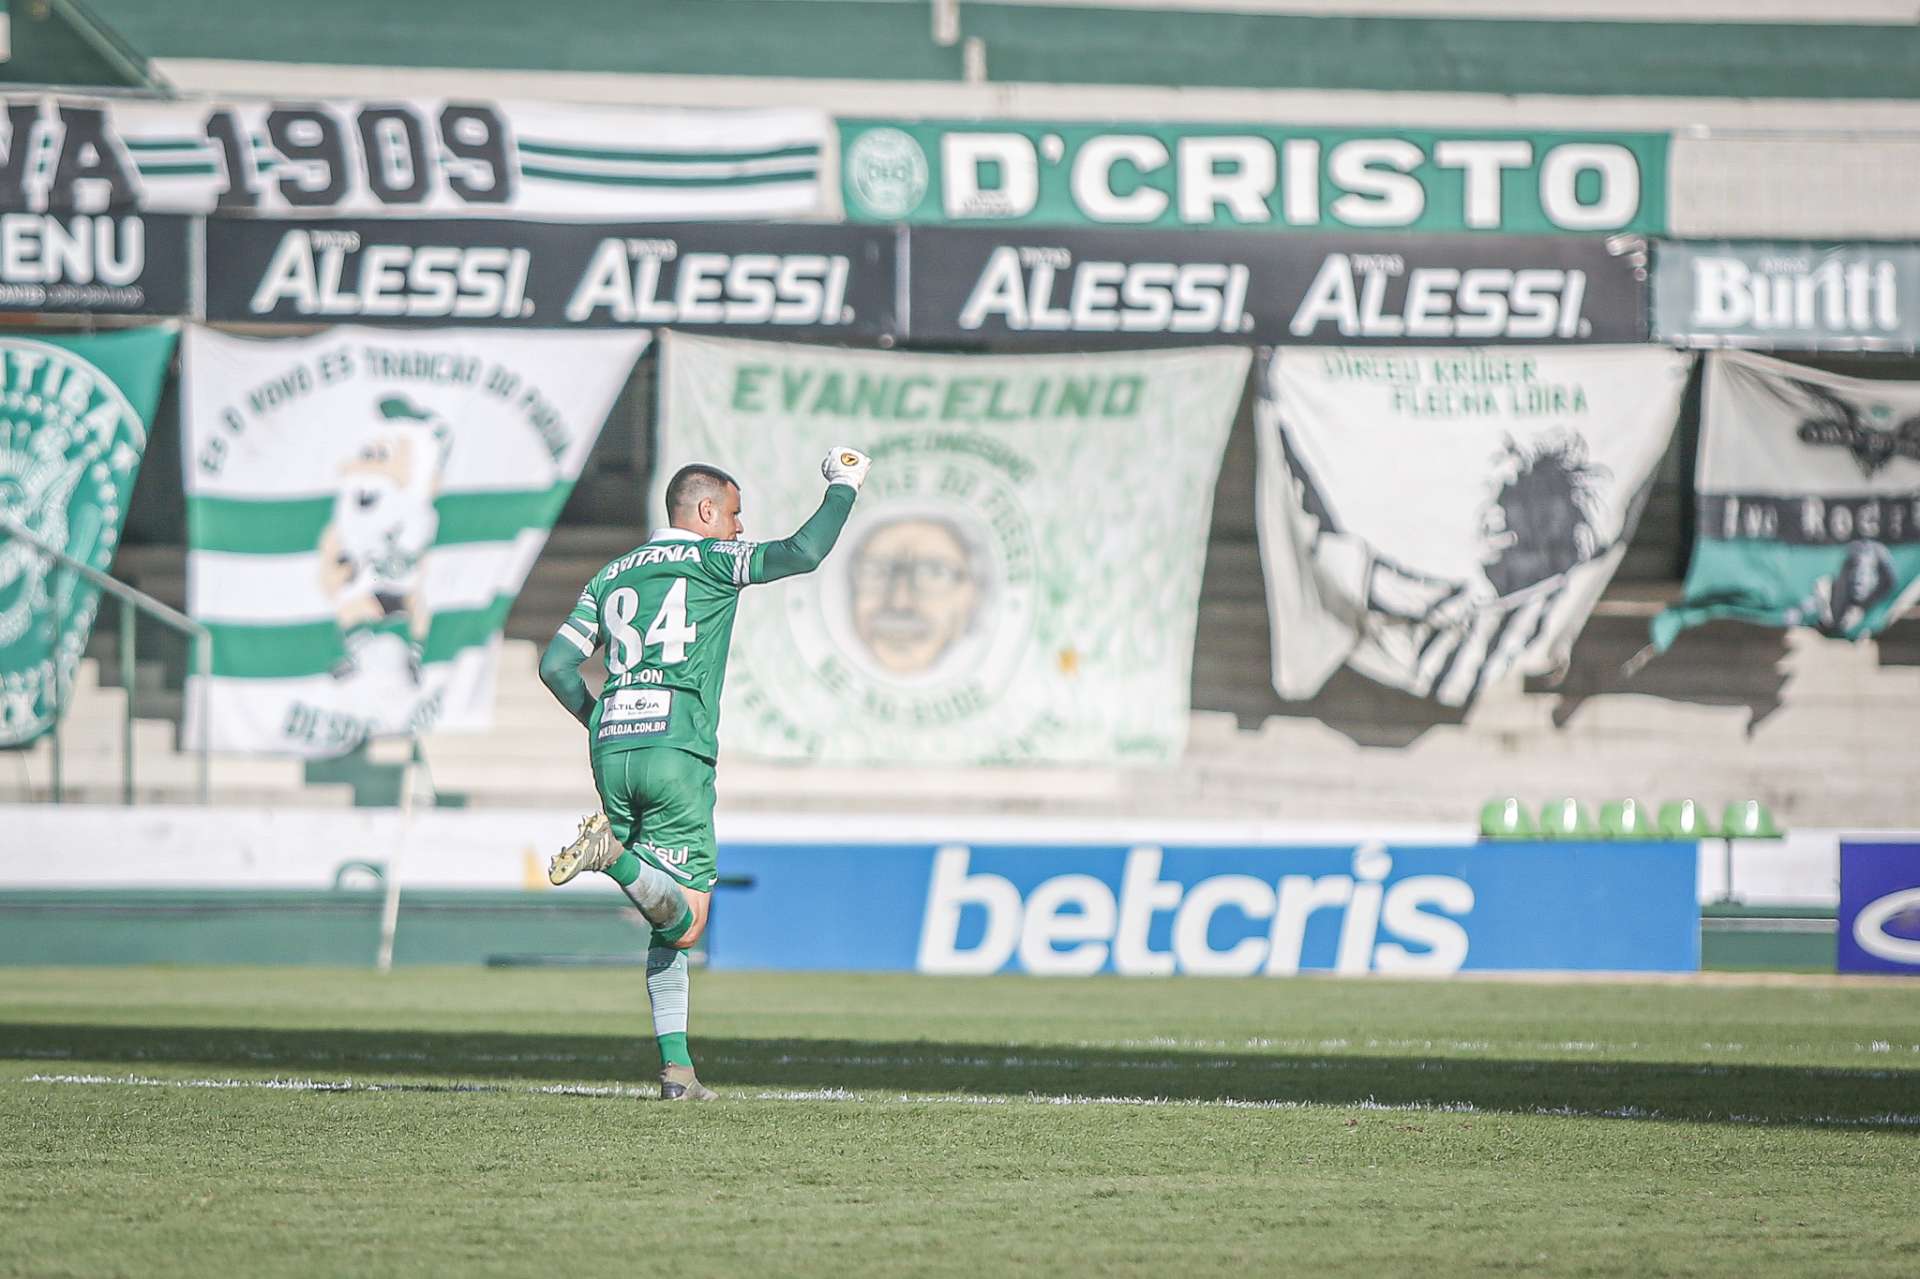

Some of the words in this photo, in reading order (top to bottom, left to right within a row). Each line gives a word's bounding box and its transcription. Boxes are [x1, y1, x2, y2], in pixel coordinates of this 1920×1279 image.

[206, 105, 515, 207] 1909
[941, 131, 1641, 230] D'CRISTO
[250, 229, 532, 318] ALESSI
[566, 238, 850, 325] ALESSI
[959, 246, 1250, 333] ALESSI
[1290, 252, 1587, 338] ALESSI
[604, 576, 697, 675] 84
[917, 842, 1475, 976] betcris
